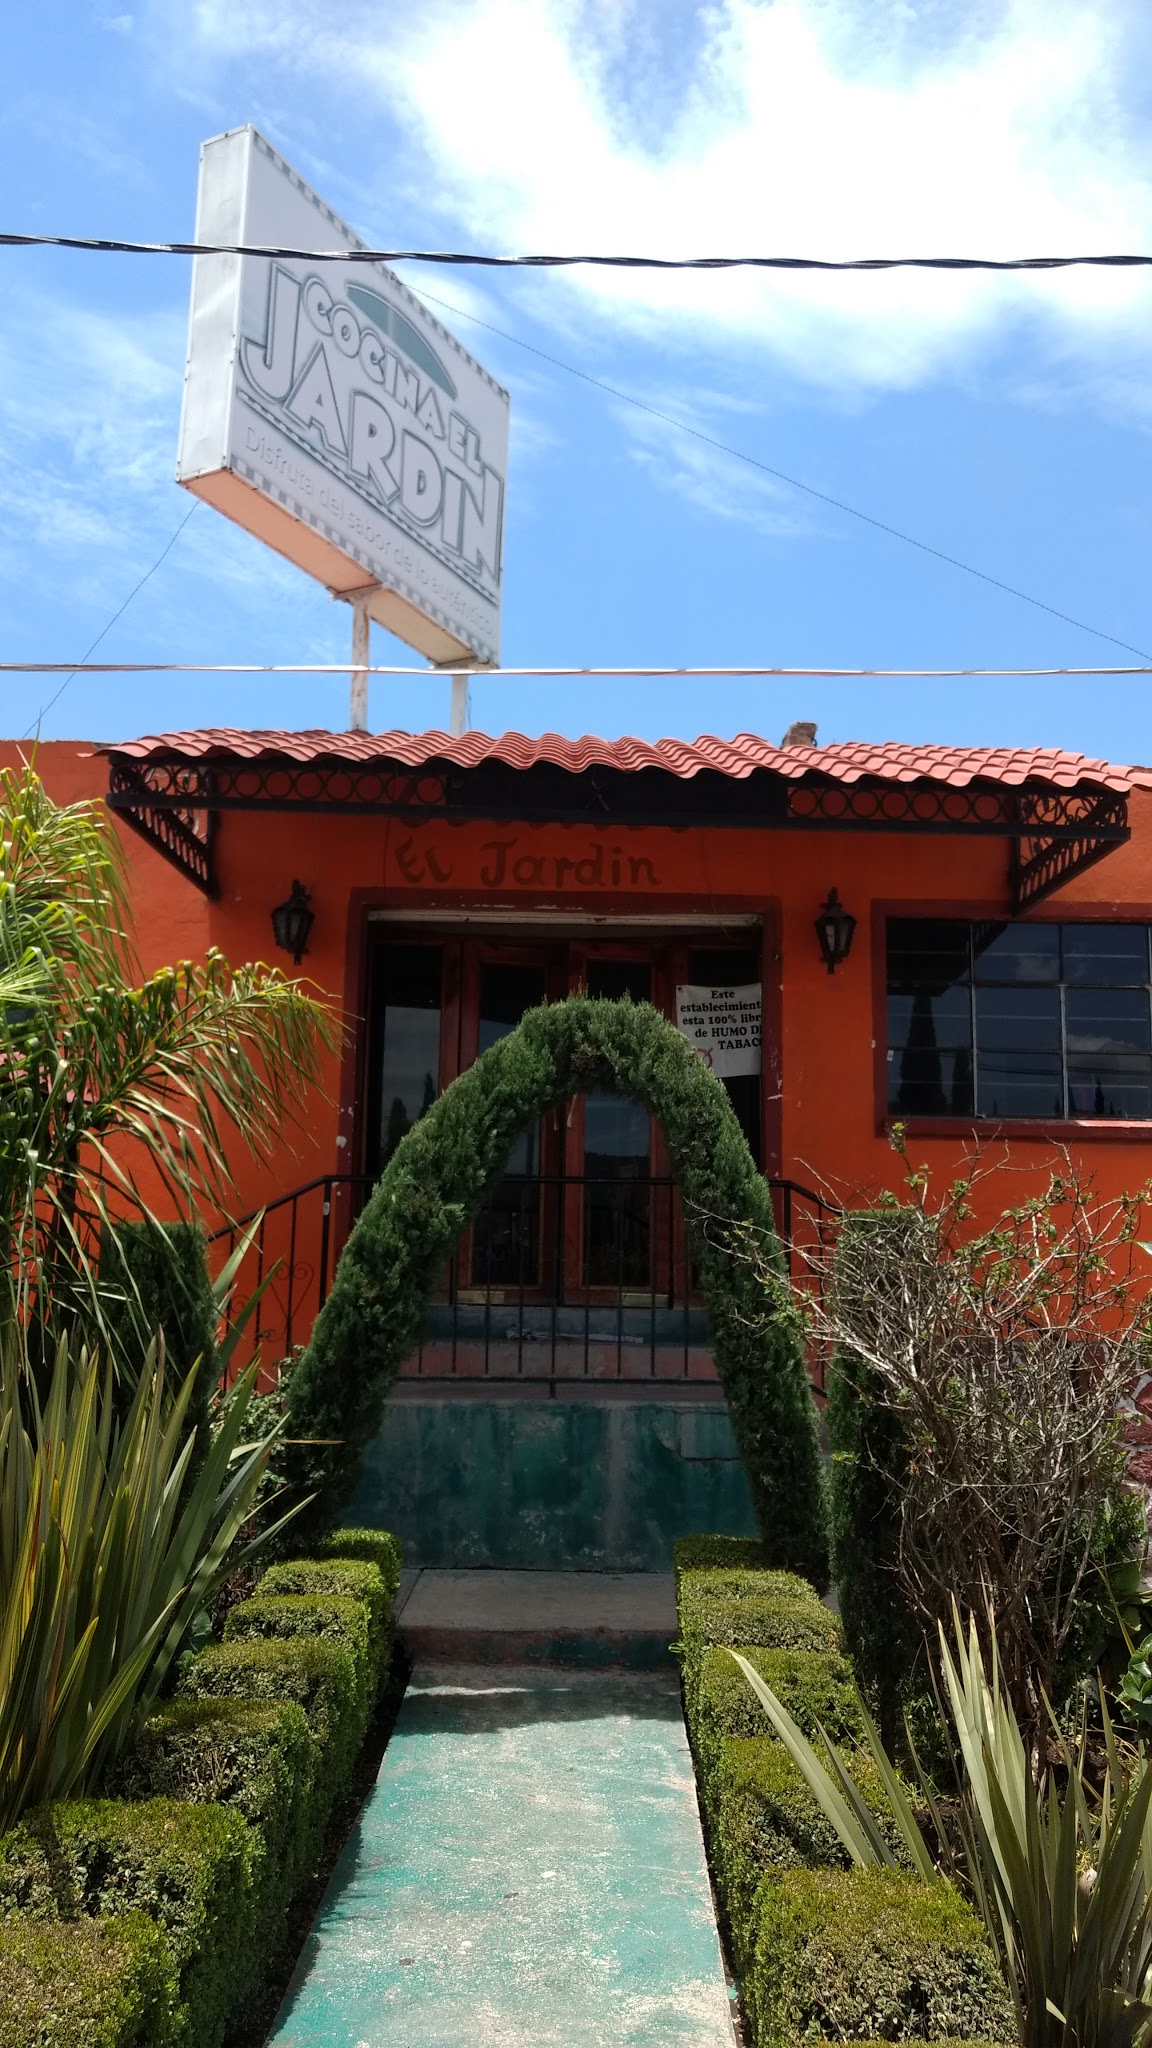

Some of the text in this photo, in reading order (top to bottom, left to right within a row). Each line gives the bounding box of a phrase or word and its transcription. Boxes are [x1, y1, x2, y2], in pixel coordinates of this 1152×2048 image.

[304, 276, 483, 476] COCINA EL
[239, 264, 504, 587] JARDIN
[245, 426, 313, 495] Disfruta
[320, 483, 344, 521] del
[394, 836, 663, 887] El Jardin
[711, 990, 735, 999] Este
[680, 1001, 761, 1012] establecimient
[682, 1013, 761, 1025] esta 100% libr
[695, 1025, 761, 1038] de HUMO D
[718, 1037, 761, 1050] TABAC
